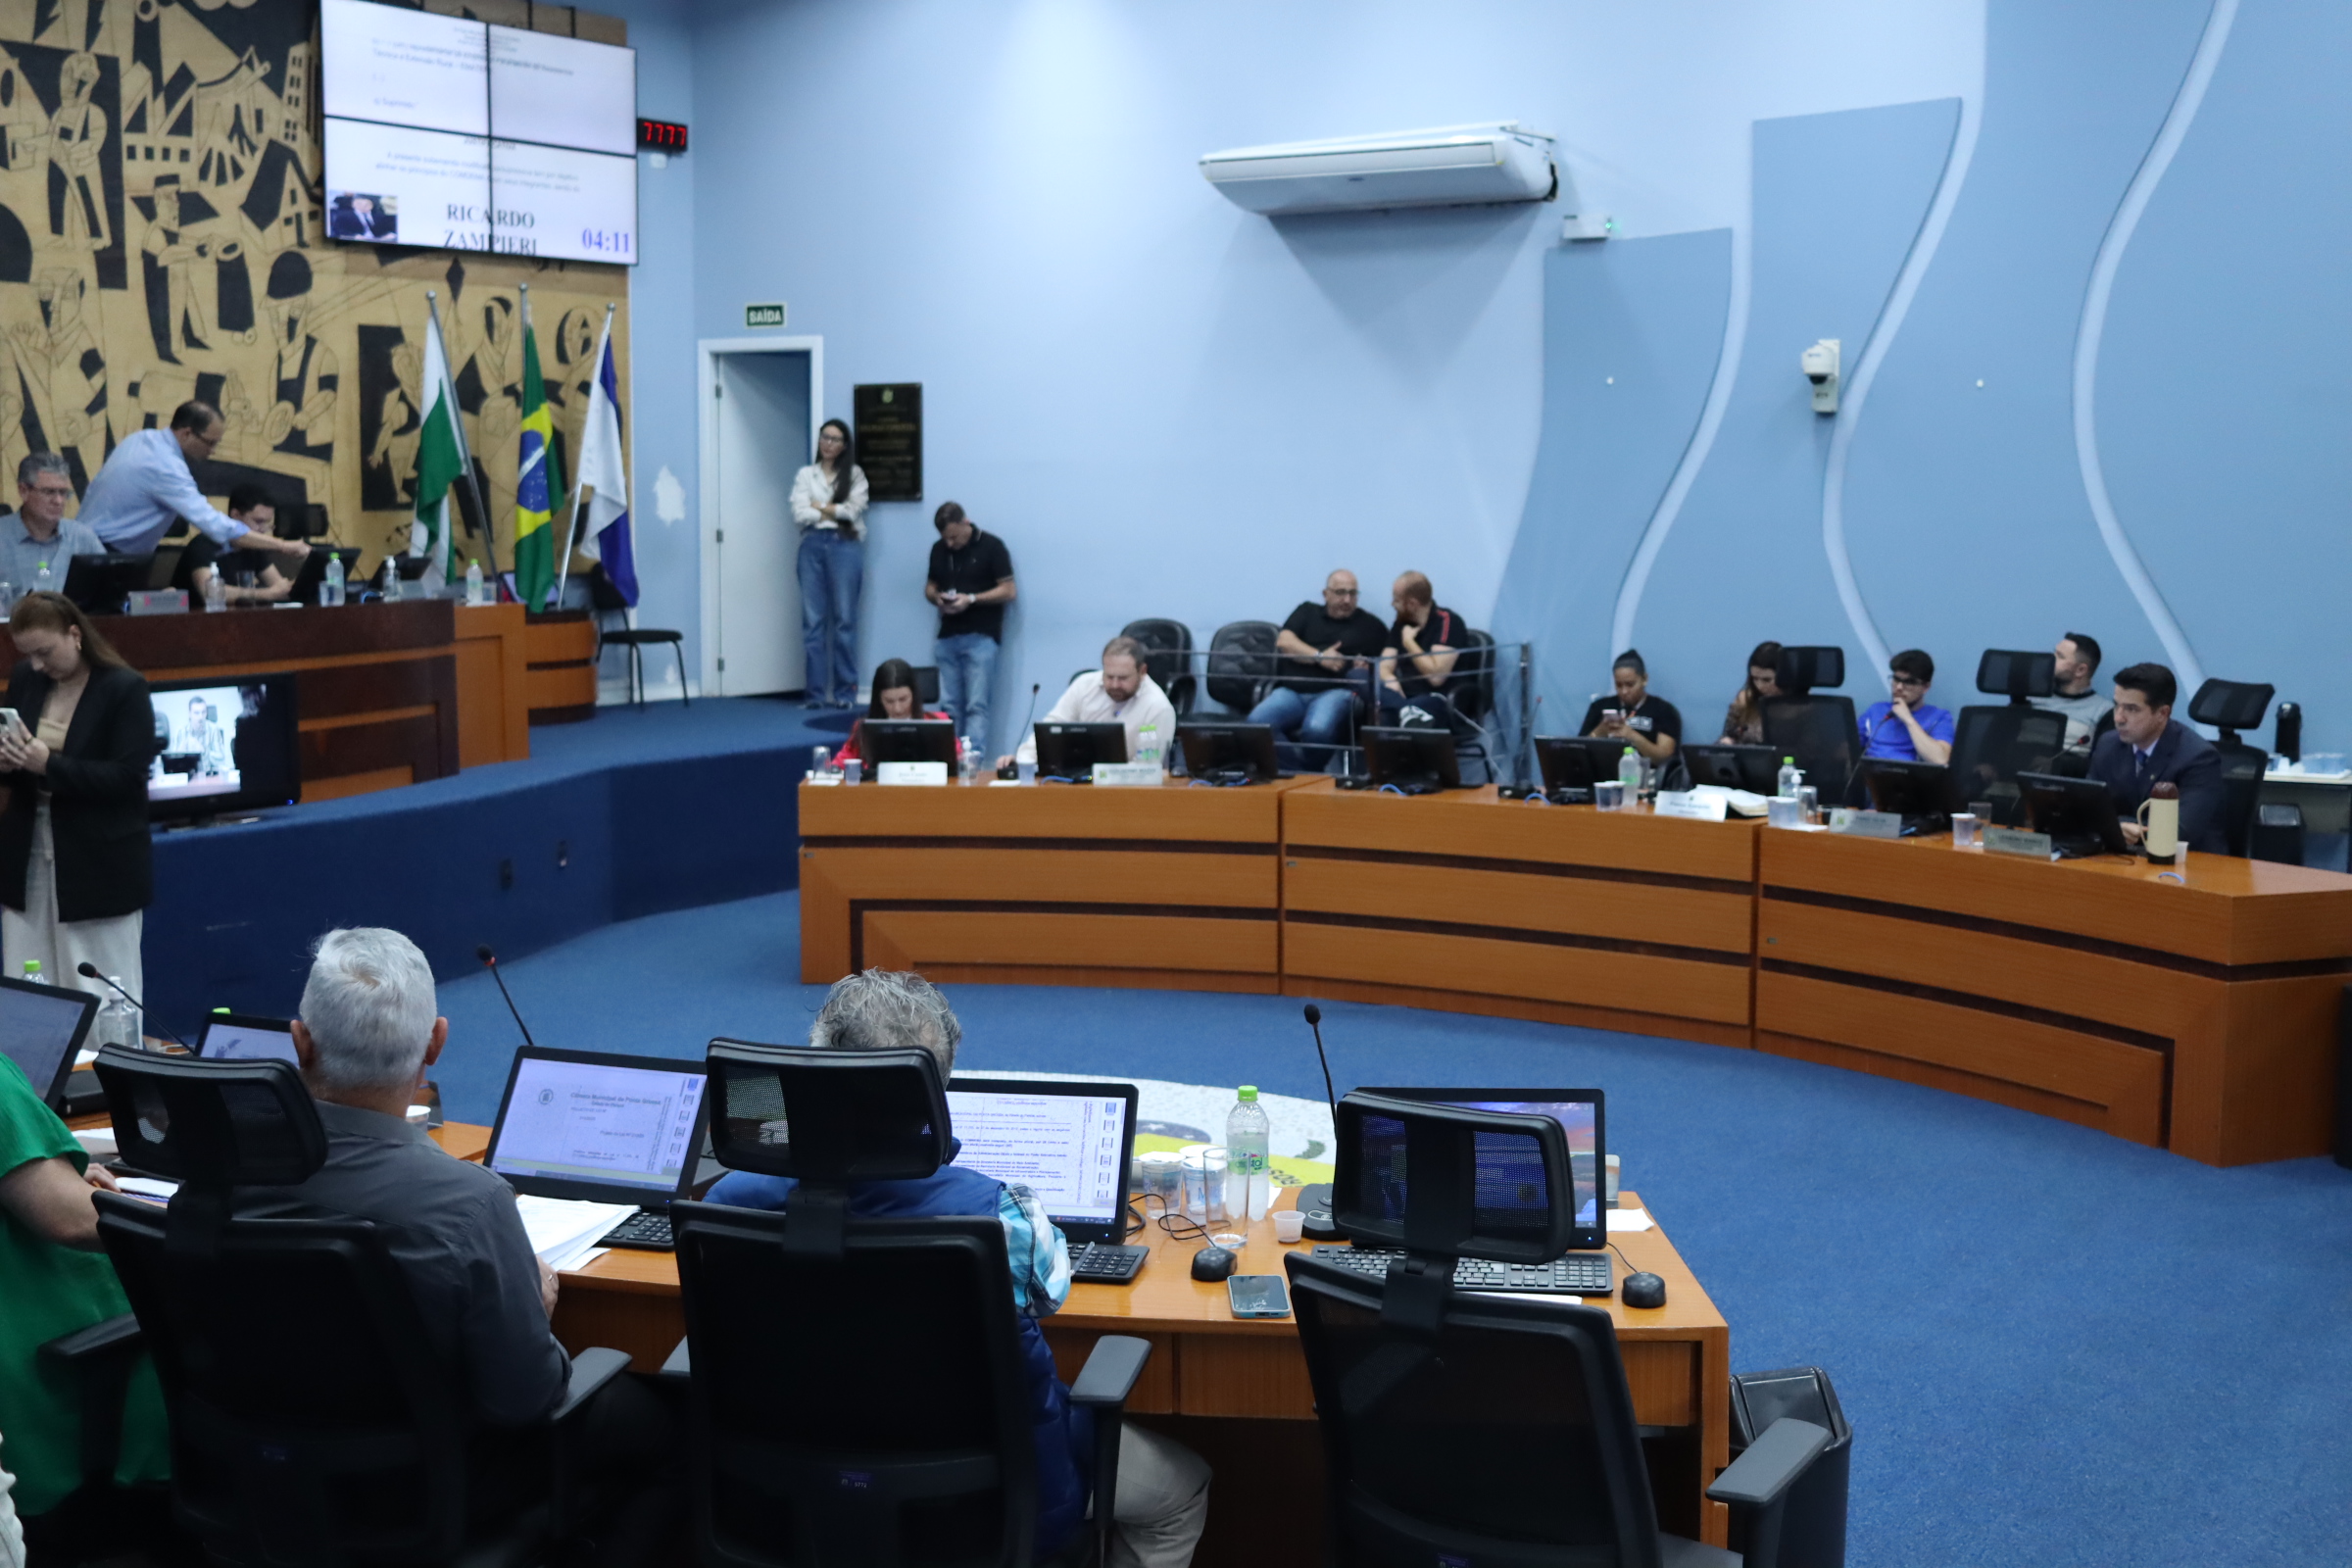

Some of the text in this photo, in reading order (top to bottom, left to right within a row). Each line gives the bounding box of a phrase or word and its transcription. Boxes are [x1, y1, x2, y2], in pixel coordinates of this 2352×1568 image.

[643, 122, 687, 146] 7777
[447, 203, 535, 229] RICARDO
[445, 229, 536, 256] ZAMPIERI
[582, 227, 629, 253] 04:11
[749, 307, 782, 323] SAÍDA
